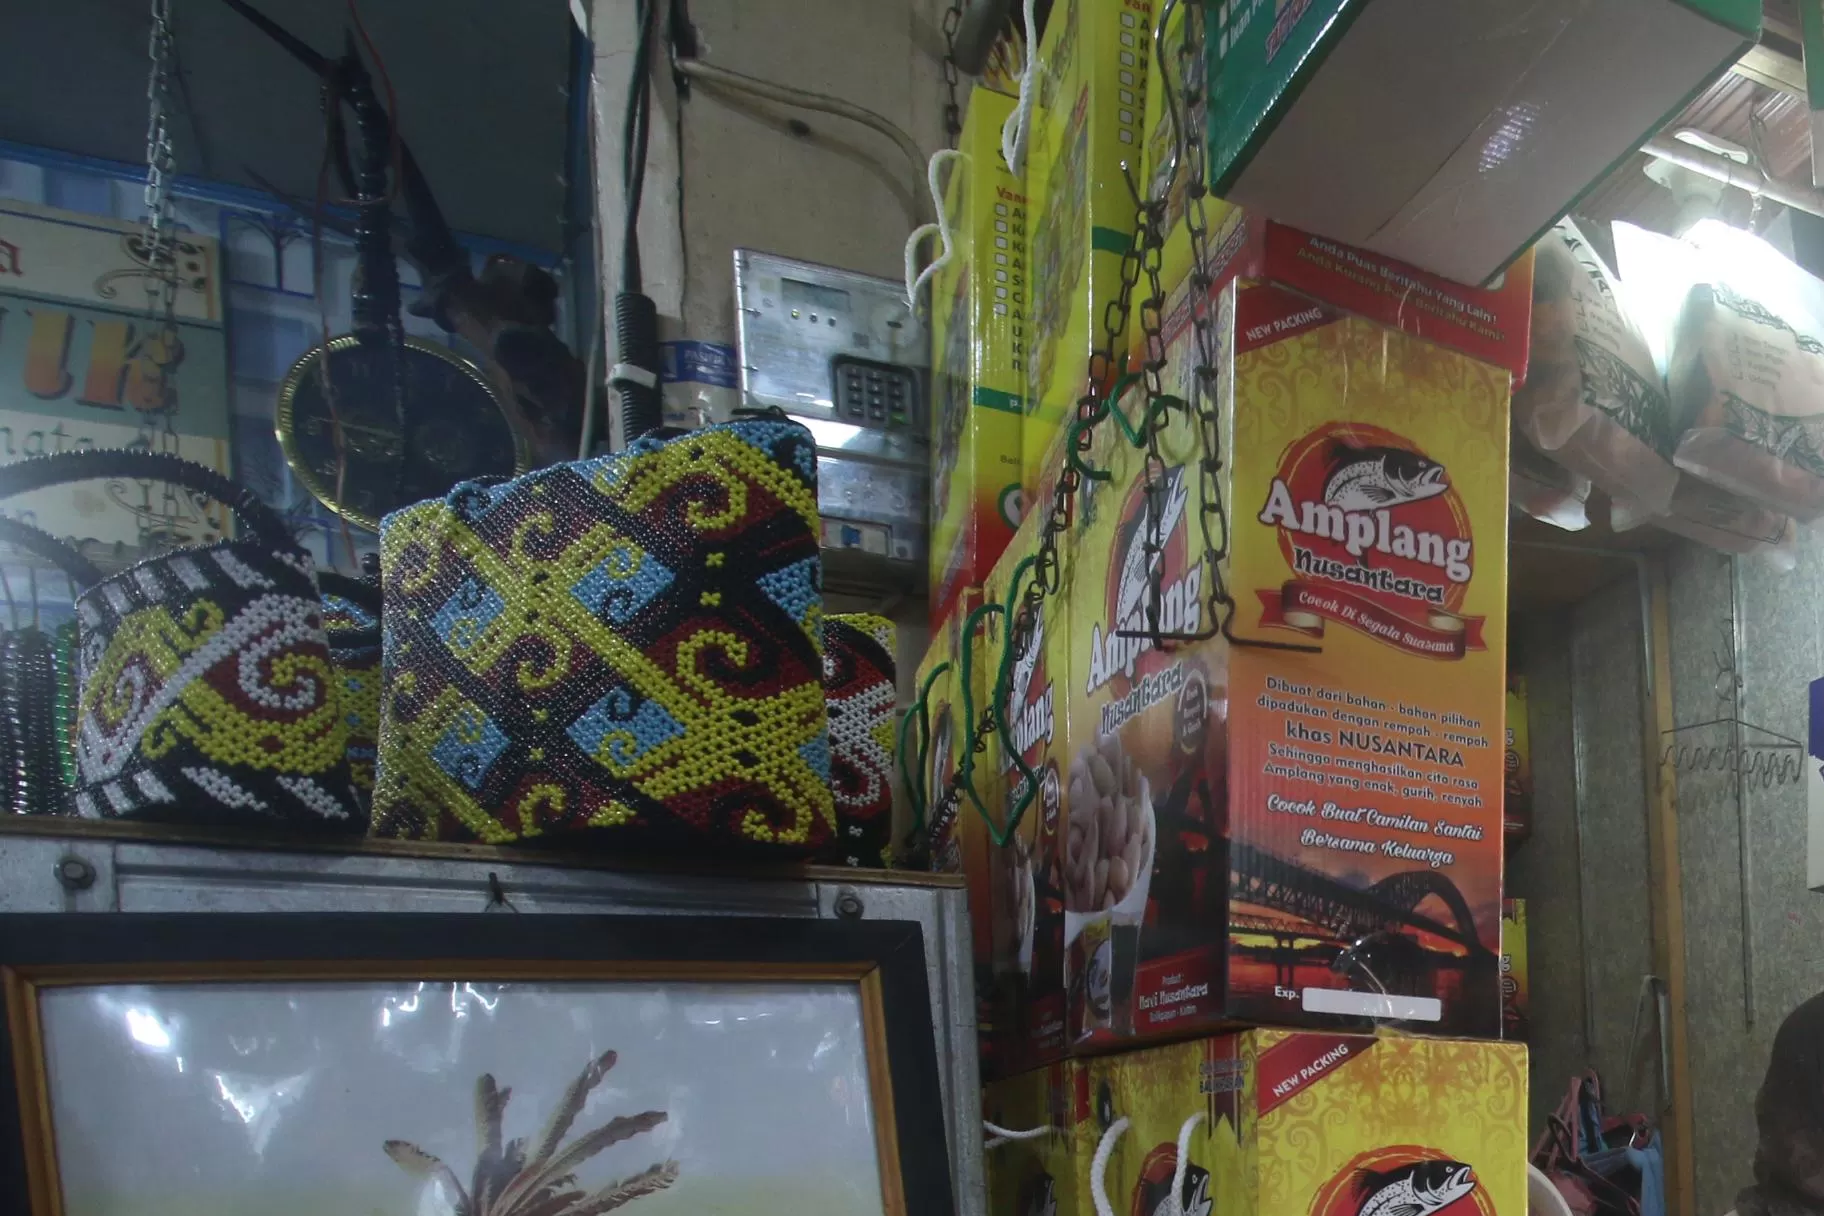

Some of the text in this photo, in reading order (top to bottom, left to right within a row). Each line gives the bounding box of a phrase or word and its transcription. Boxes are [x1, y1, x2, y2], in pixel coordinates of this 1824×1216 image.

[1297, 248, 1332, 271] Anda
[1334, 262, 1381, 291] Kurang
[1309, 237, 1344, 260] Anda
[1346, 250, 1377, 273] Puas
[1380, 265, 1436, 297] Beritahu
[1436, 288, 1466, 313] Yang
[1245, 307, 1323, 342] NEW PACKING
[1258, 476, 1472, 583] Amplang
[1293, 546, 1446, 604] Nusantara
[1299, 591, 1456, 653] Cocok Di Segala Suasana
[1257, 696, 1489, 749] dipadukan dengan rempah rempah
[1267, 676, 1482, 731] Dibuat dari bahan bahan pilihan
[1269, 743, 1479, 790] Sehingga menghasilkan cita rasa
[1286, 720, 1465, 768] khas NUSANTARA
[1264, 762, 1483, 809] Amplang yang enak, gurih, renyah
[1267, 793, 1485, 842] Cocok Buat Camilan Santai
[1301, 827, 1455, 869] Bersama Keluarga
[1274, 985, 1300, 1001] Exp.
[1272, 1074, 1300, 1098] NEW
[1299, 1043, 1349, 1080] PACKING
